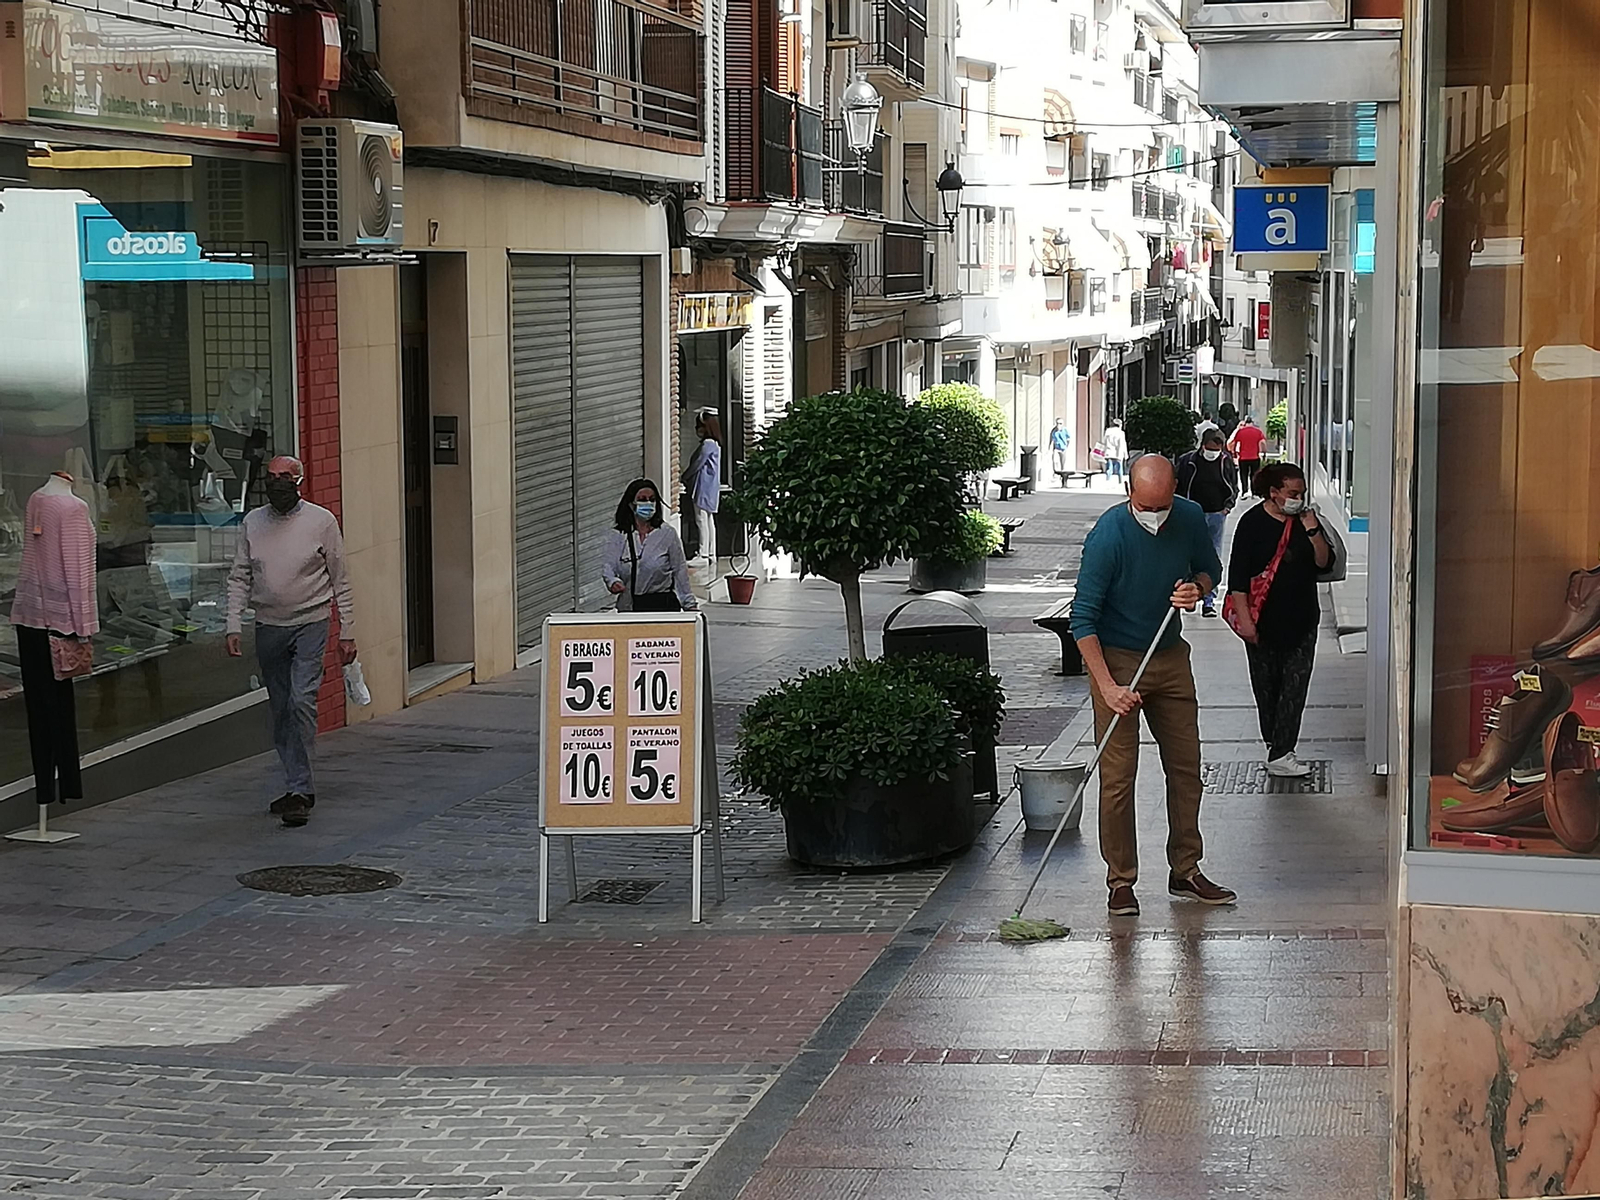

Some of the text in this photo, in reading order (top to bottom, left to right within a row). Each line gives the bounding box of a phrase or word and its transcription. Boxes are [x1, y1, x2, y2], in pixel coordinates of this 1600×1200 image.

[428, 219, 439, 246] 7
[565, 643, 611, 657] 6 BRAGAS
[631, 650, 680, 660] DE VERANO
[566, 661, 612, 712] 5€
[634, 669, 678, 712] 10€
[571, 728, 604, 737] JUEGOS
[563, 741, 612, 751] DE TOALLAS
[630, 739, 679, 747] DE VERANO
[565, 753, 611, 799] 10€
[630, 749, 676, 801] 5€
